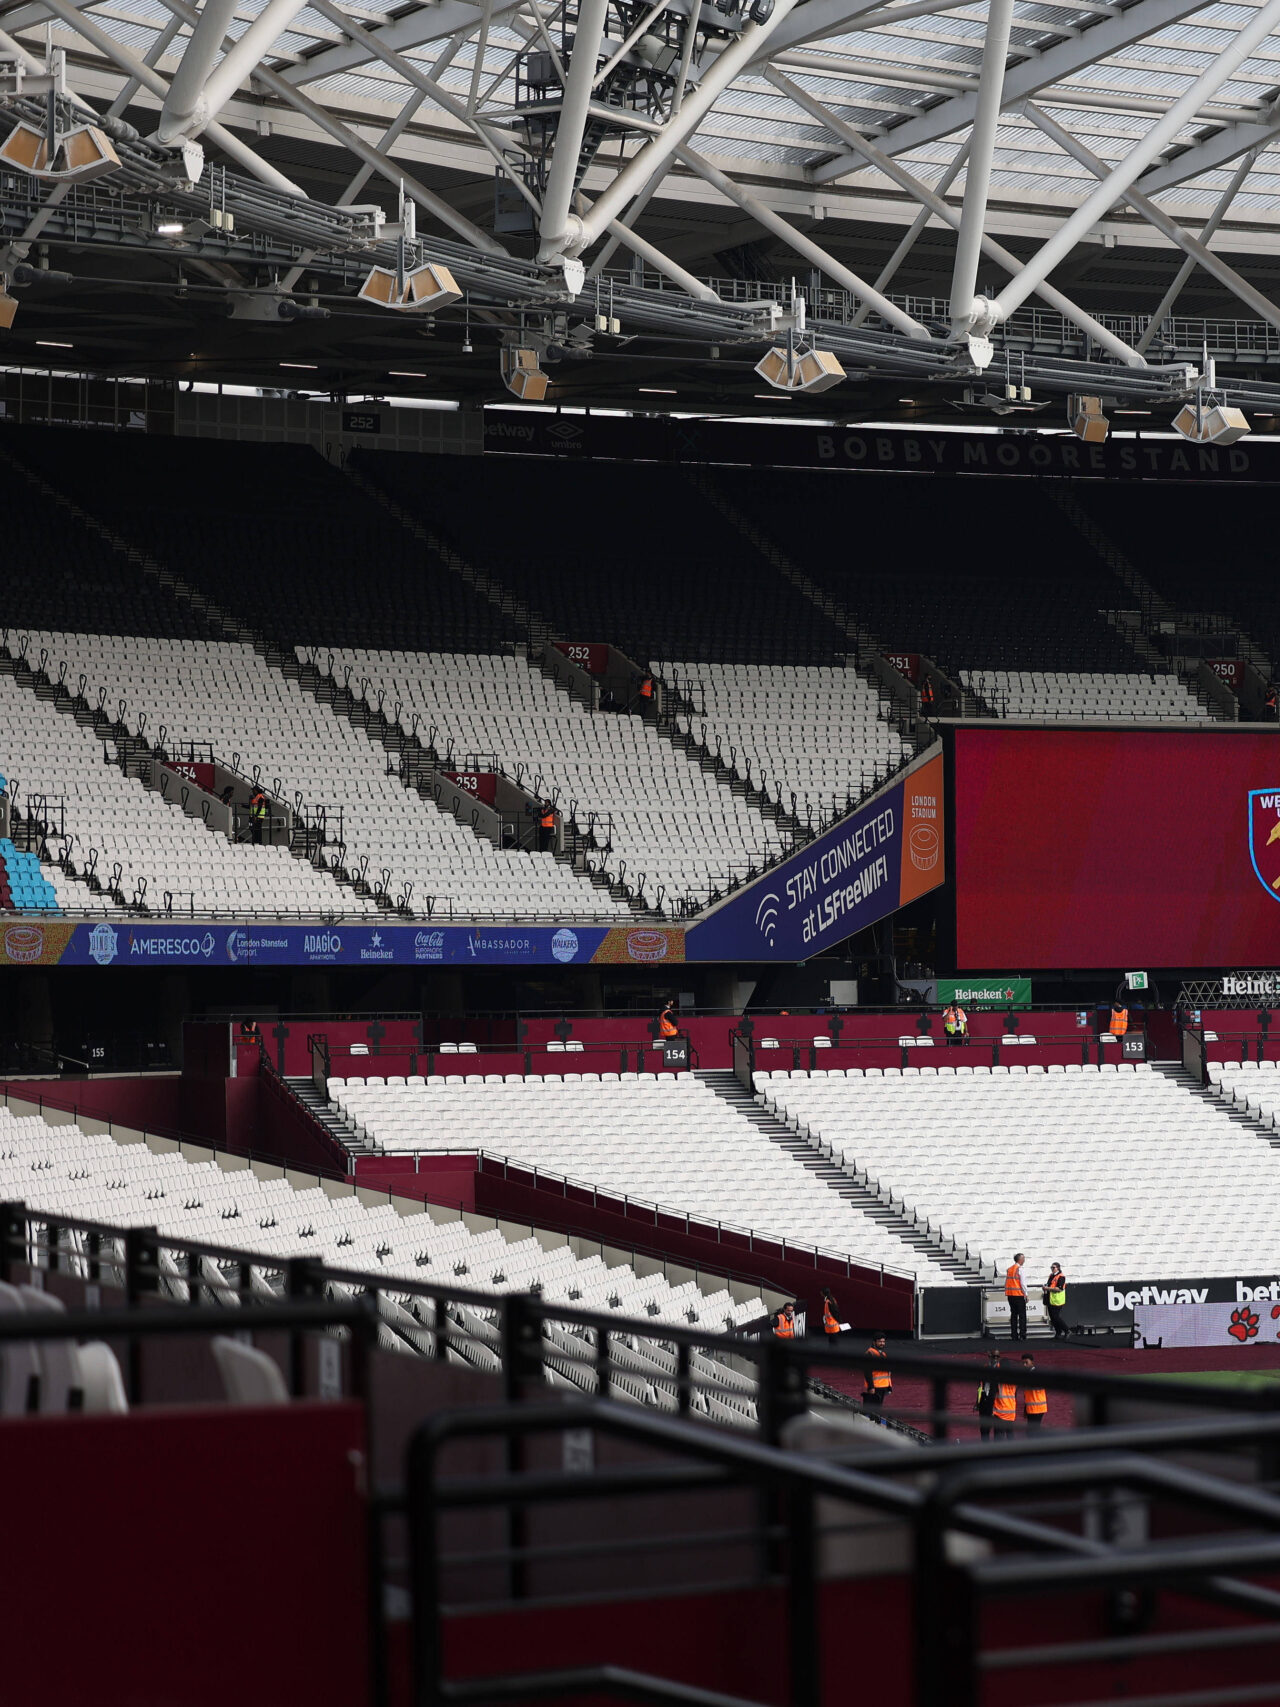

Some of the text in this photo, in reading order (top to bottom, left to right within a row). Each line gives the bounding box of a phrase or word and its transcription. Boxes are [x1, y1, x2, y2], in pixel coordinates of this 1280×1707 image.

[350, 416, 374, 429] 252
[551, 439, 582, 449] umbro
[816, 434, 1251, 472] BOBBY MOORE STAND
[568, 646, 590, 659] 252
[889, 656, 910, 669] 251
[1213, 663, 1235, 675] 250
[456, 776, 478, 790] 253
[911, 795, 936, 806] LONDON
[911, 807, 936, 819] STADIUM
[785, 808, 894, 910] STAY CONNECTED
[802, 854, 889, 943] at LSFreeWIFI
[130, 938, 200, 955] AMERESCO
[237, 939, 288, 948] London Stansted
[467, 935, 530, 956] AMBASSADOR
[552, 938, 578, 949] WALKERS
[237, 948, 257, 957] Airport
[360, 948, 393, 959] Heineken
[954, 988, 1002, 1000] Heineken
[92, 1048, 104, 1058] 155
[1124, 1042, 1143, 1052] 153
[666, 1050, 685, 1060] 154
[1107, 1286, 1209, 1311] betway
